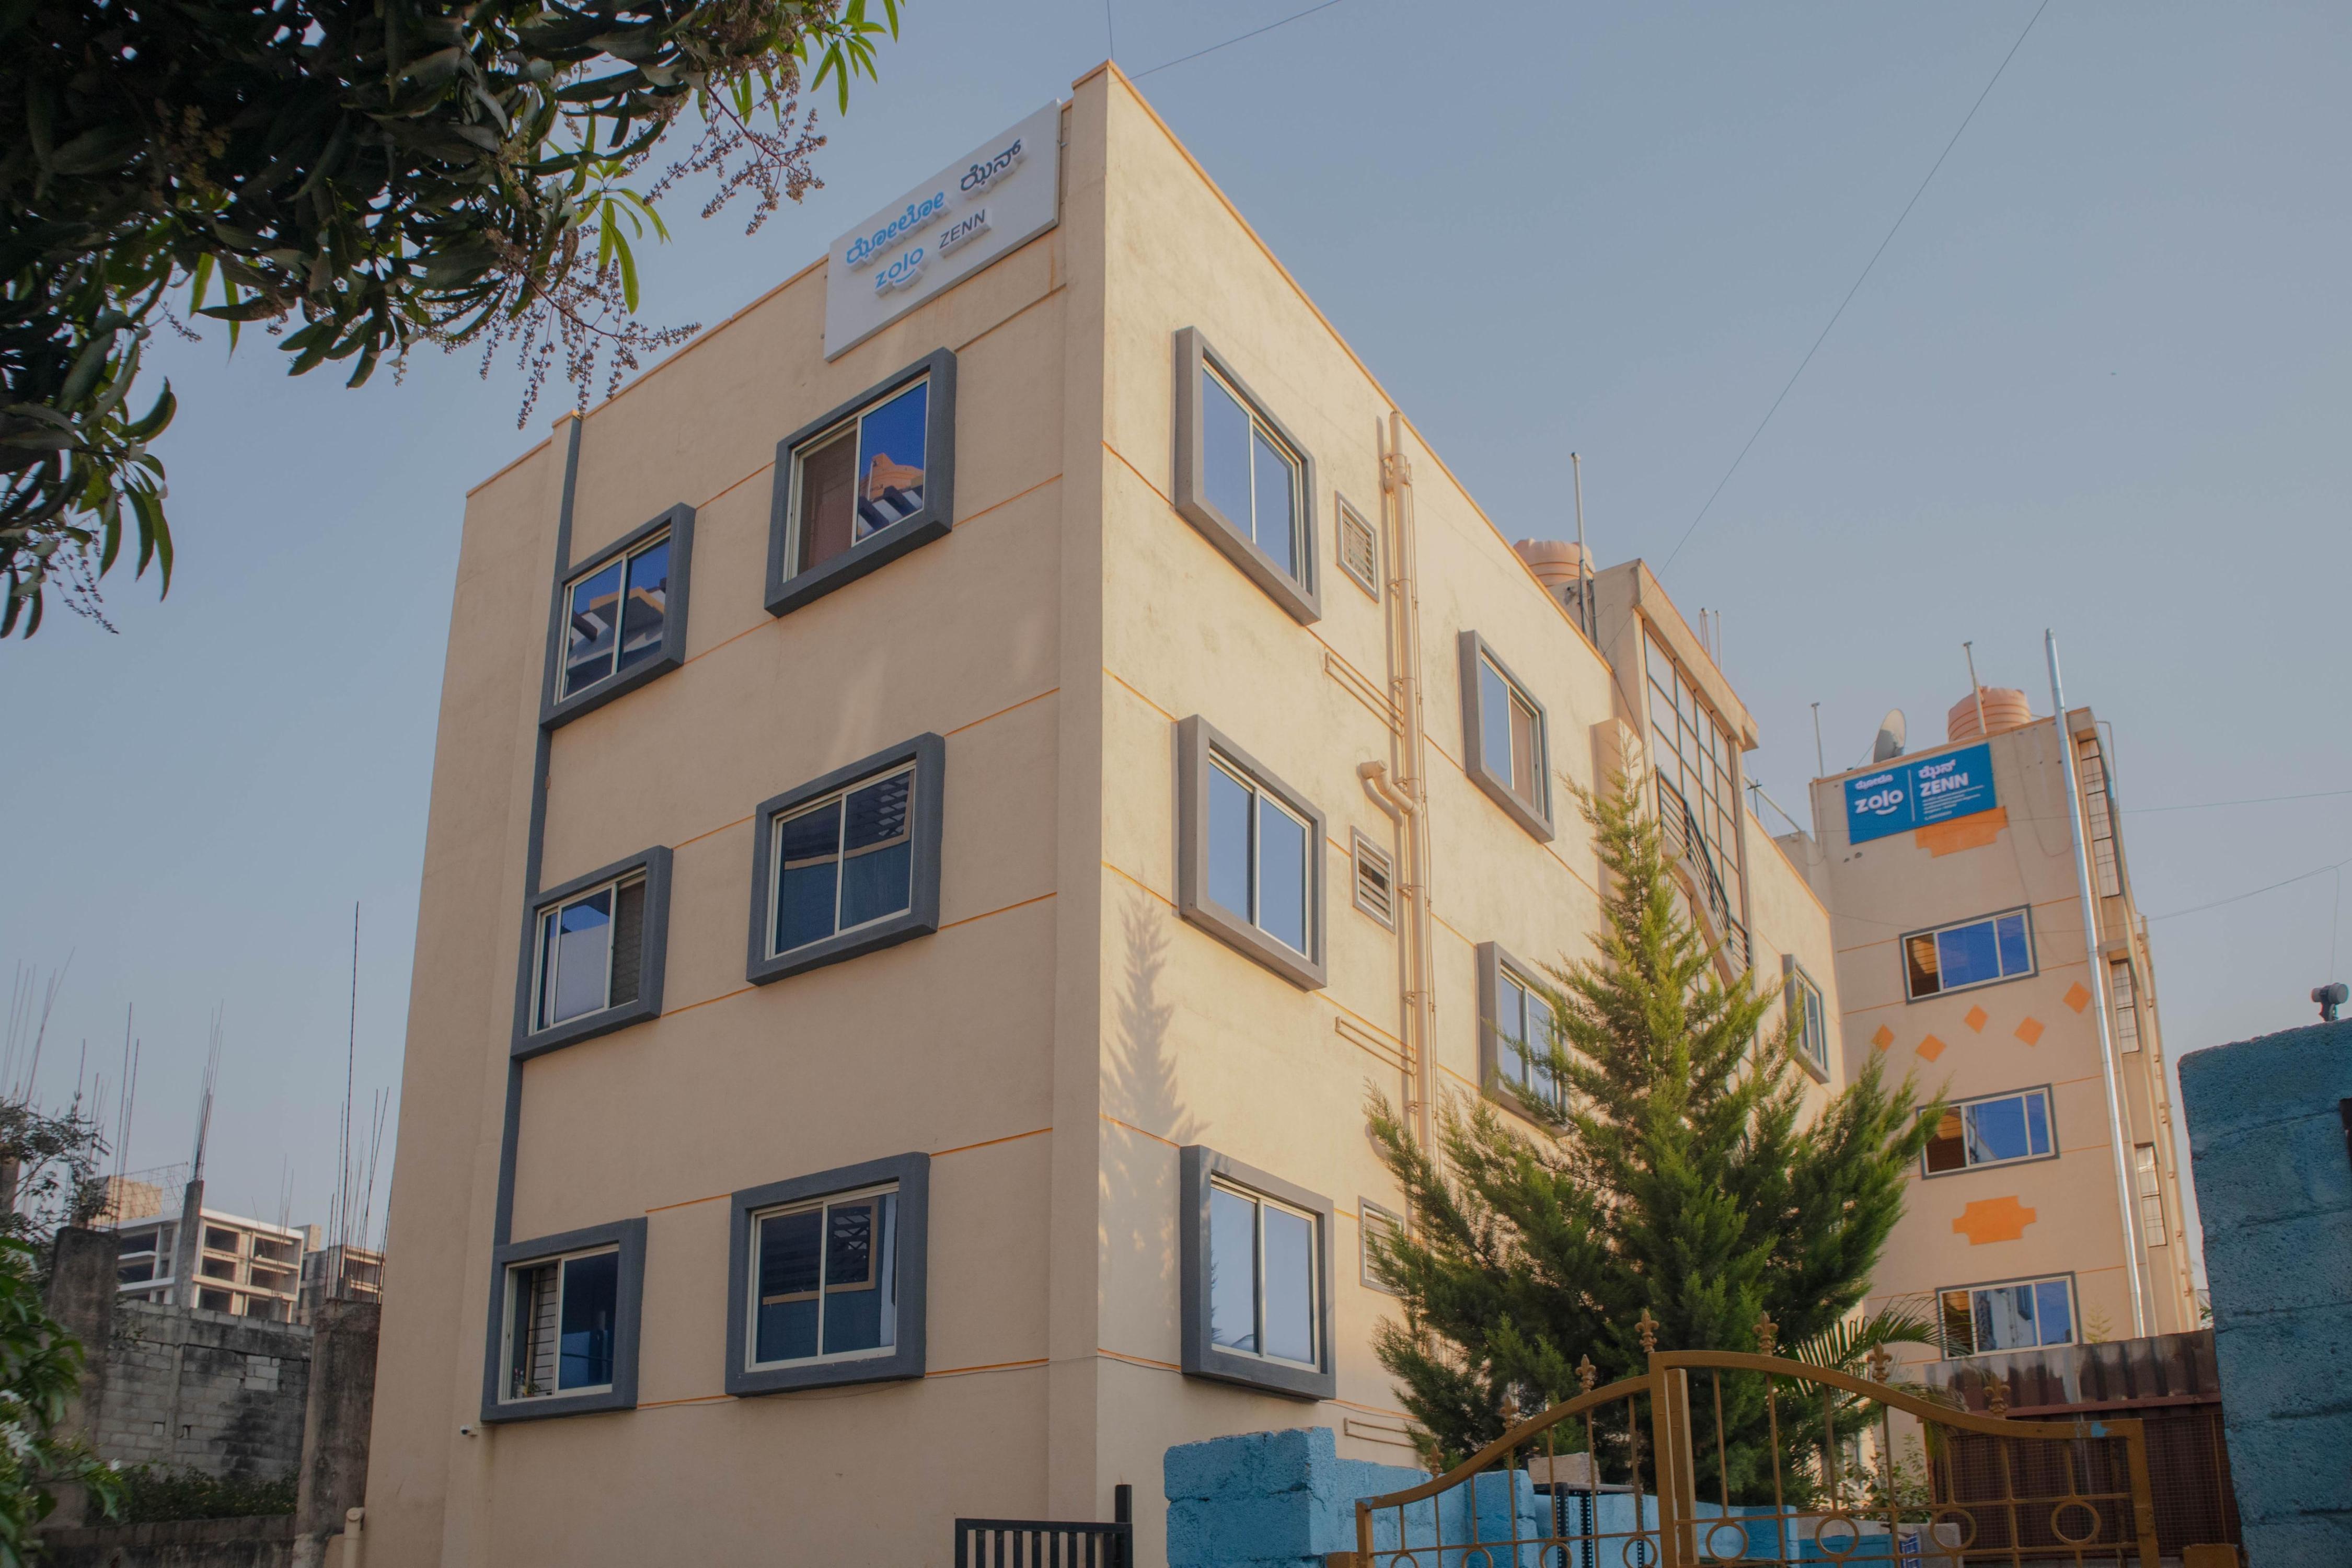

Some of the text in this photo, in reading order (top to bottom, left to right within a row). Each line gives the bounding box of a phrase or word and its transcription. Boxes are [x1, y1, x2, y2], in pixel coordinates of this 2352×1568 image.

[875, 209, 985, 289] zolo ZENN
[1920, 772, 1969, 797] ZENN
[1854, 789, 1904, 814] zolo
